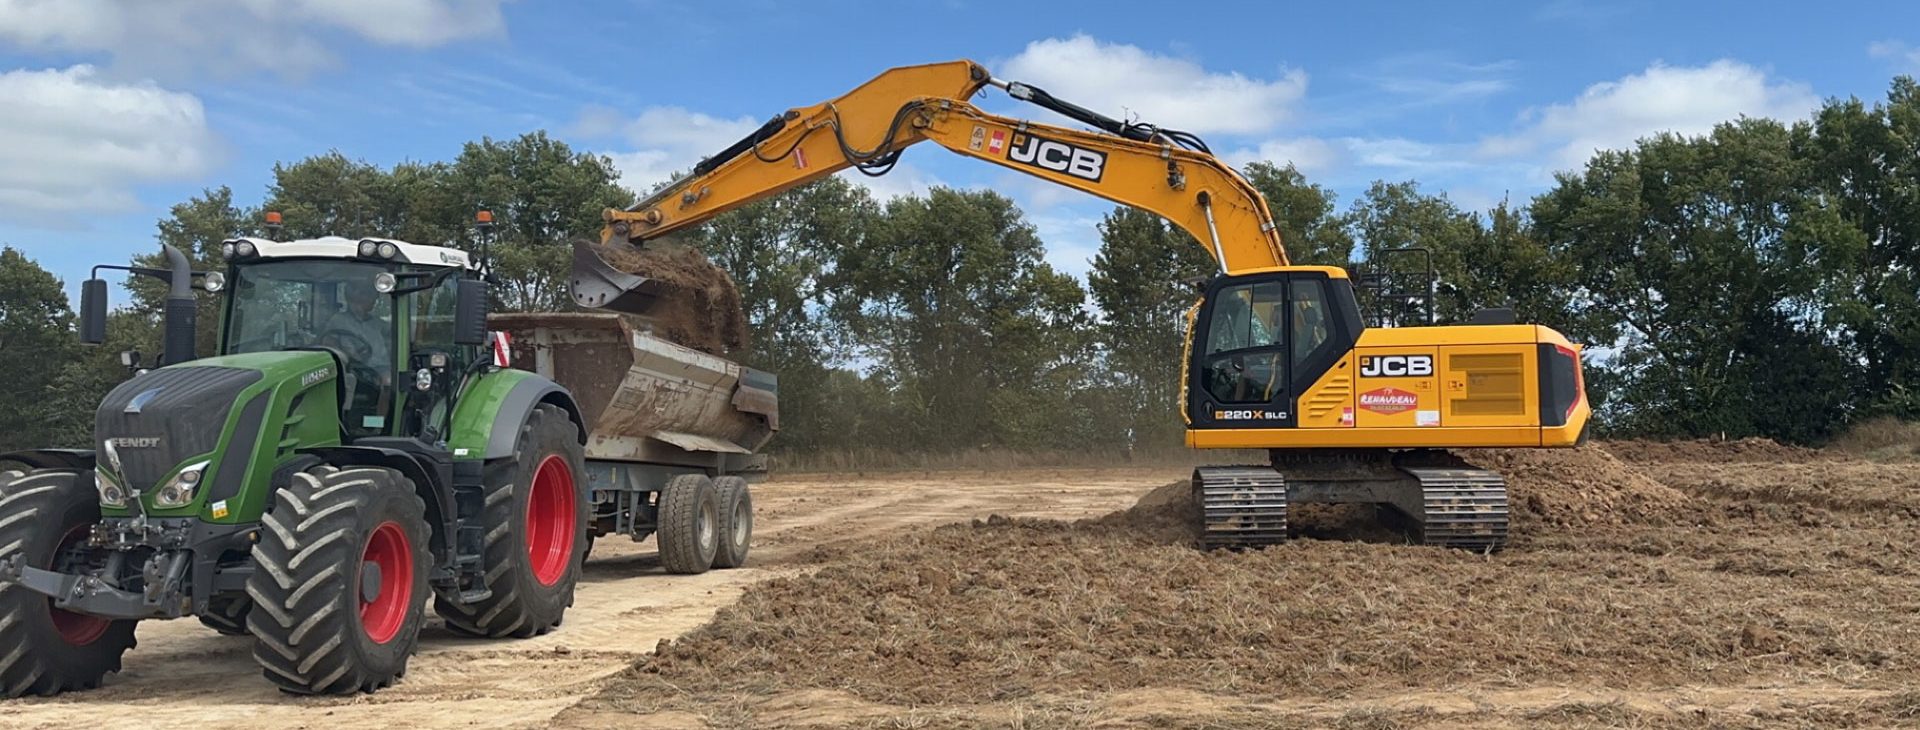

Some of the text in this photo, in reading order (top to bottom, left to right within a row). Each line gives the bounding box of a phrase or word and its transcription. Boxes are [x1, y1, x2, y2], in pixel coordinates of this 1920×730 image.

[1010, 137, 1103, 179] JCB
[1361, 356, 1432, 376] JCB
[1360, 394, 1417, 404] RENAUDEAU
[1224, 410, 1264, 419] 220X
